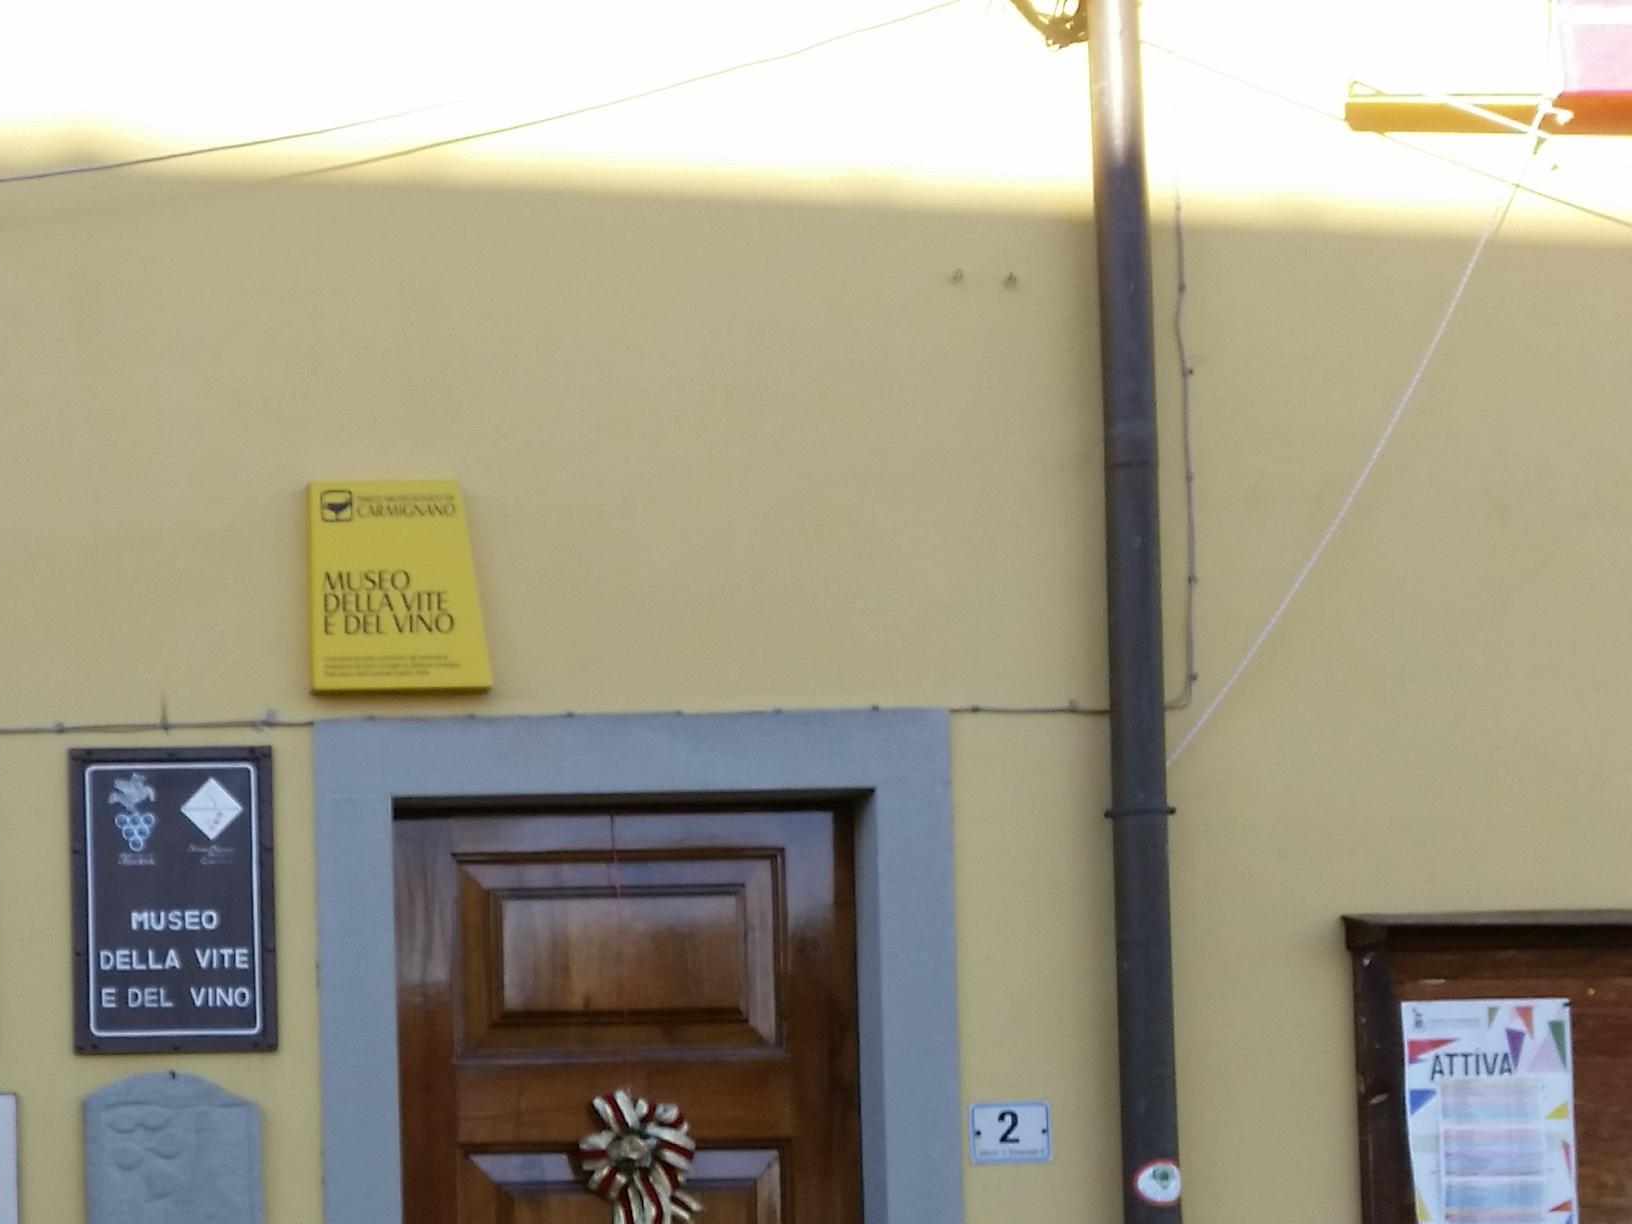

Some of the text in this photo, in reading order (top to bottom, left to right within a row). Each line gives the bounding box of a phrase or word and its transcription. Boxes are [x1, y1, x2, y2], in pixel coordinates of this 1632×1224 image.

[356, 503, 456, 518] CARMIGNANO
[324, 570, 411, 591] MUSEO
[323, 591, 447, 613] DELLA VITE
[324, 612, 455, 635] E DEL VINO
[131, 910, 219, 931] MUSEO
[100, 948, 249, 970] DELLA VITE
[102, 986, 250, 1007] E DEL VINO
[1431, 1052, 1515, 1081] ATTIVA
[998, 1110, 1020, 1144] 2
